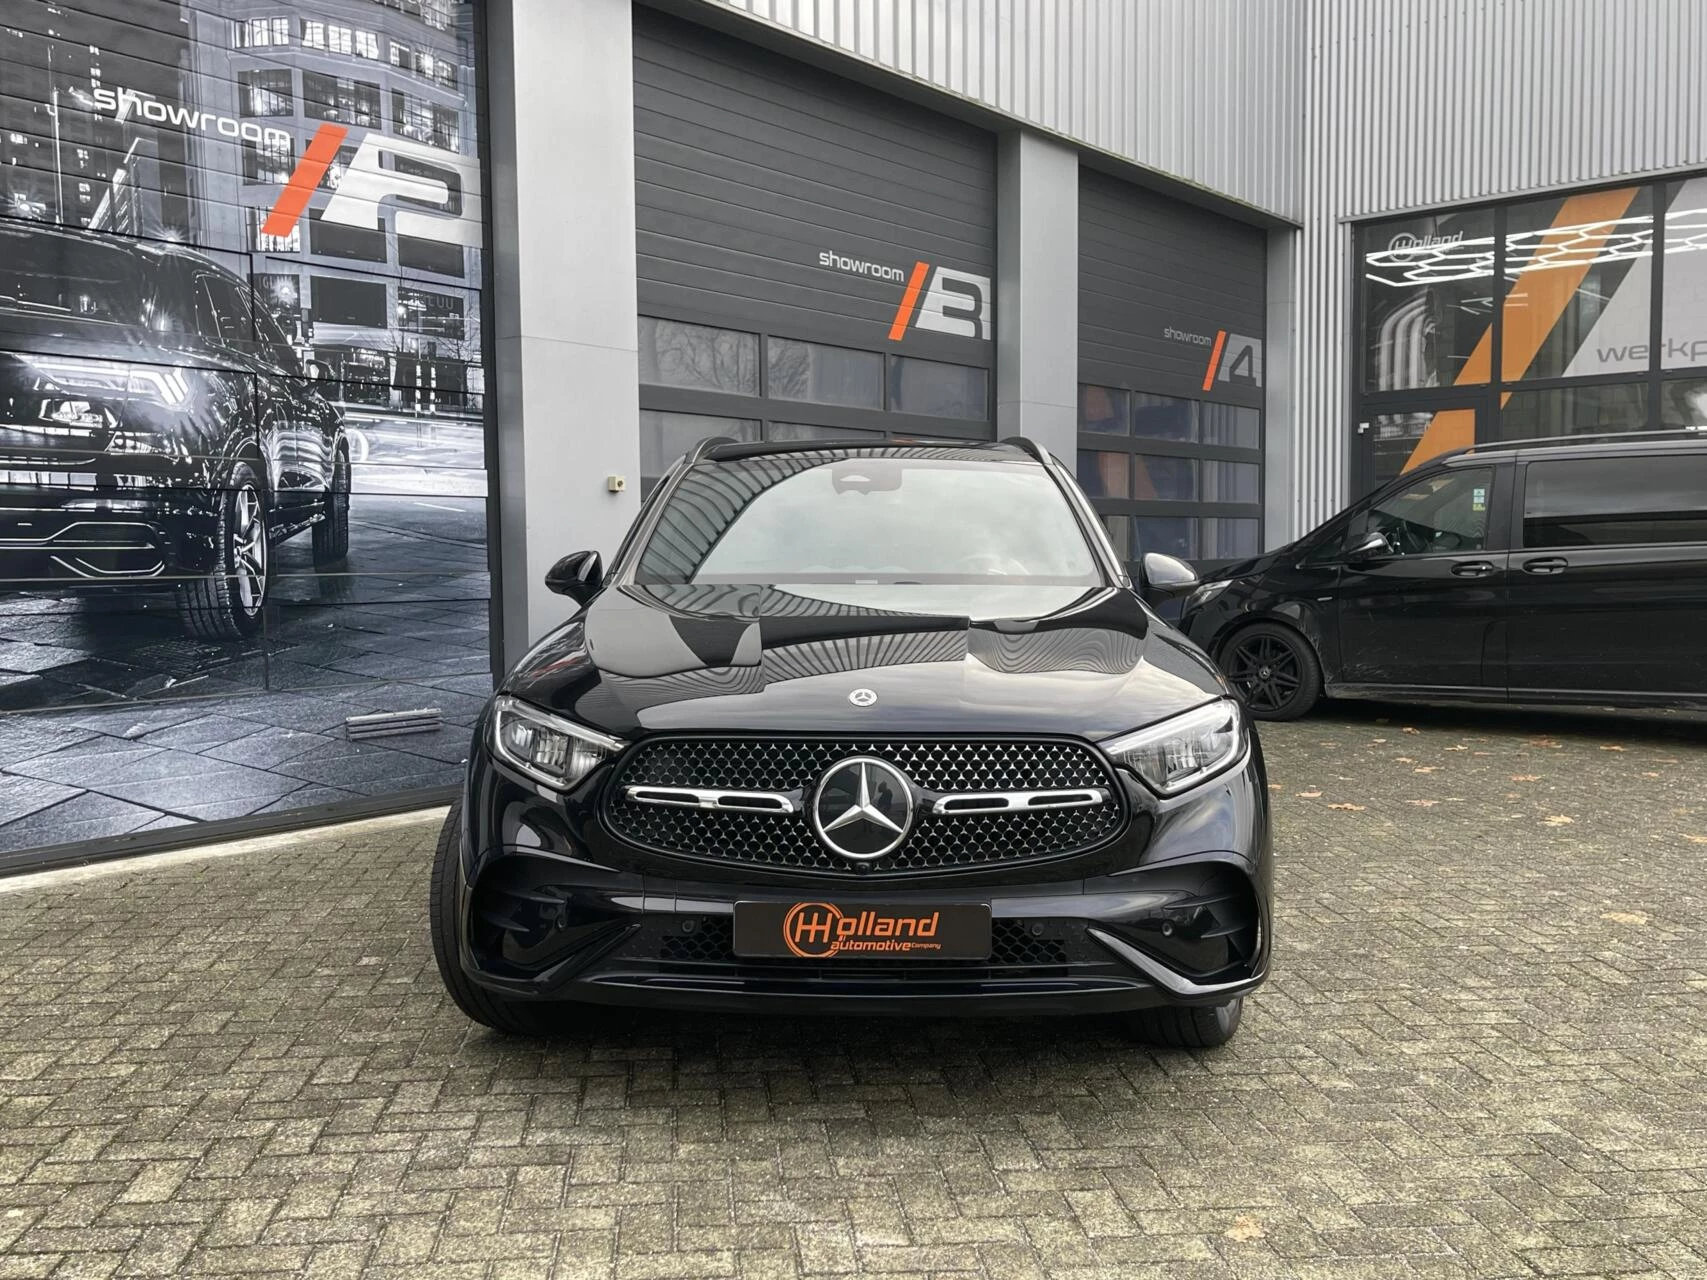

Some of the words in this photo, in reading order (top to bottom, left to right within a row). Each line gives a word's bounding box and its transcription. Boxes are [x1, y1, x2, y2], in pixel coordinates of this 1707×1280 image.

[93, 87, 291, 147] showroom
[819, 250, 905, 282] showroom
[1163, 326, 1212, 346] showroom
[1596, 338, 1707, 362] wekp
[792, 909, 940, 943] Holland
[830, 939, 911, 951] automotive
